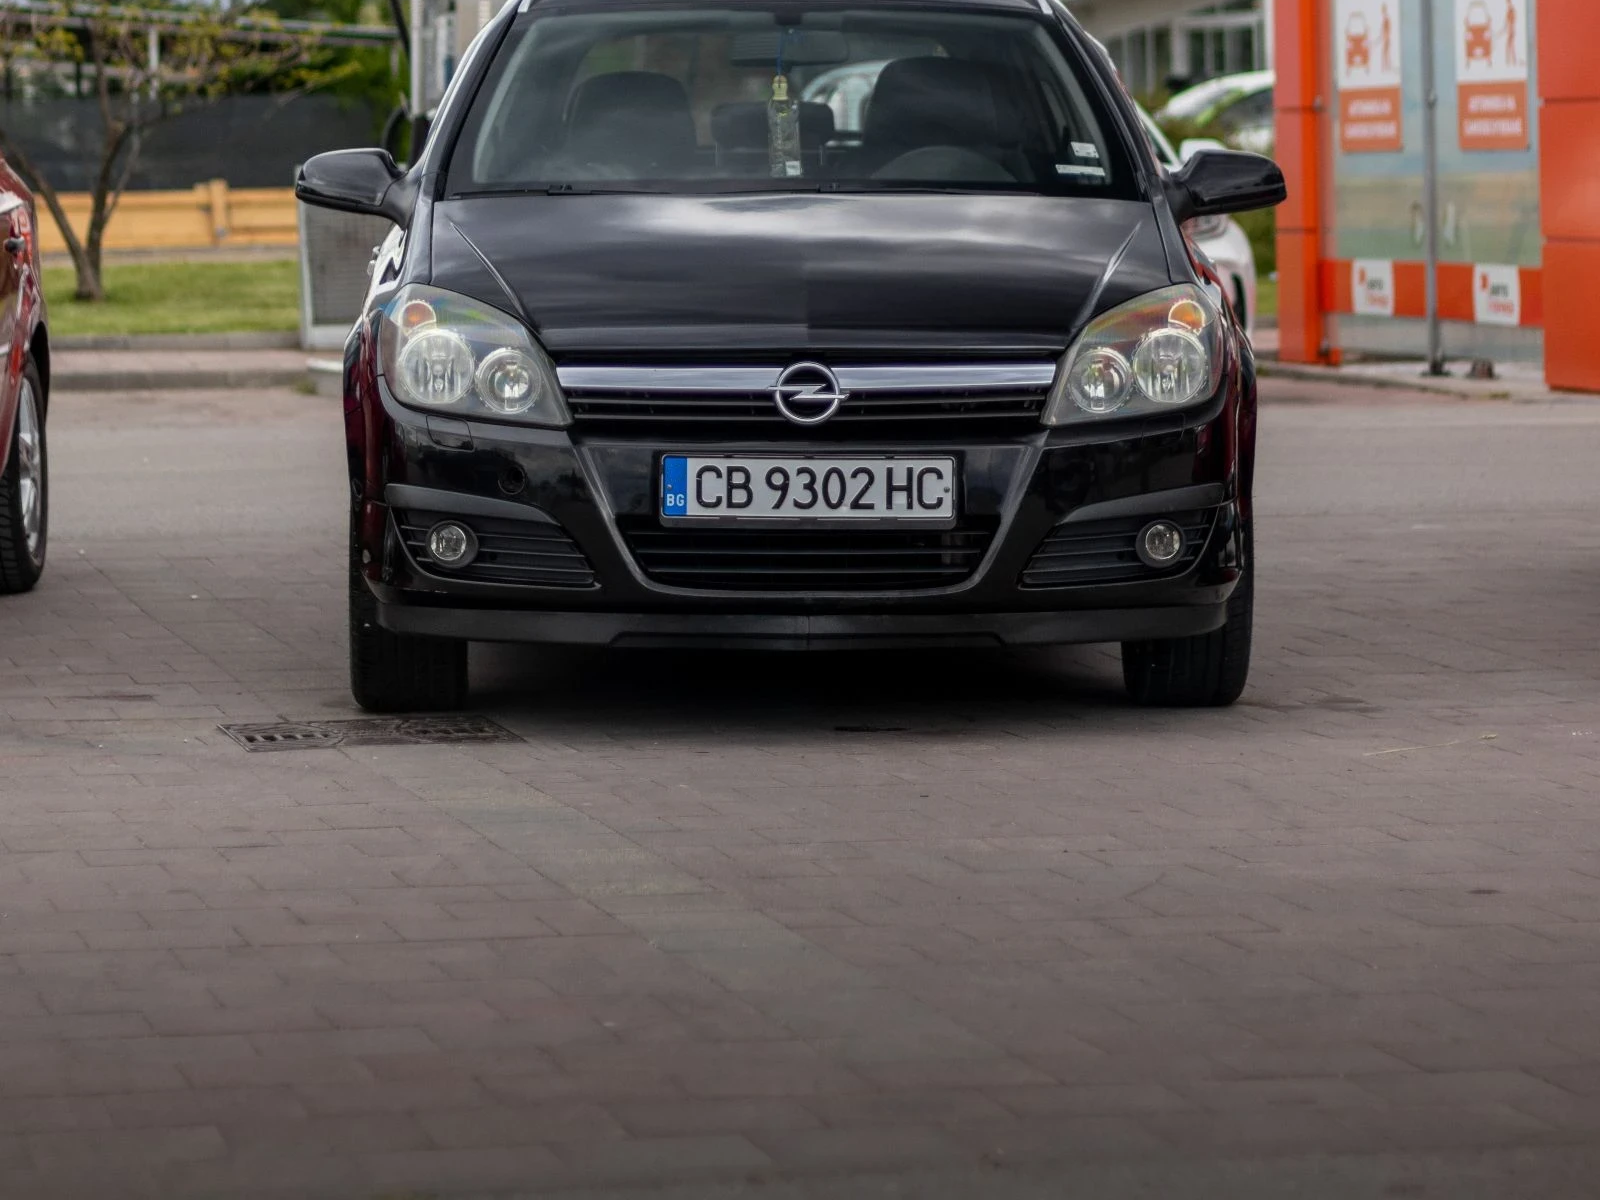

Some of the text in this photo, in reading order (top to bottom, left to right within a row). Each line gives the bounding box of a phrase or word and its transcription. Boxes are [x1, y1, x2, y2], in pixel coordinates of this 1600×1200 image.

[666, 493, 685, 507] BG
[695, 465, 944, 510] CB 9302 HC
